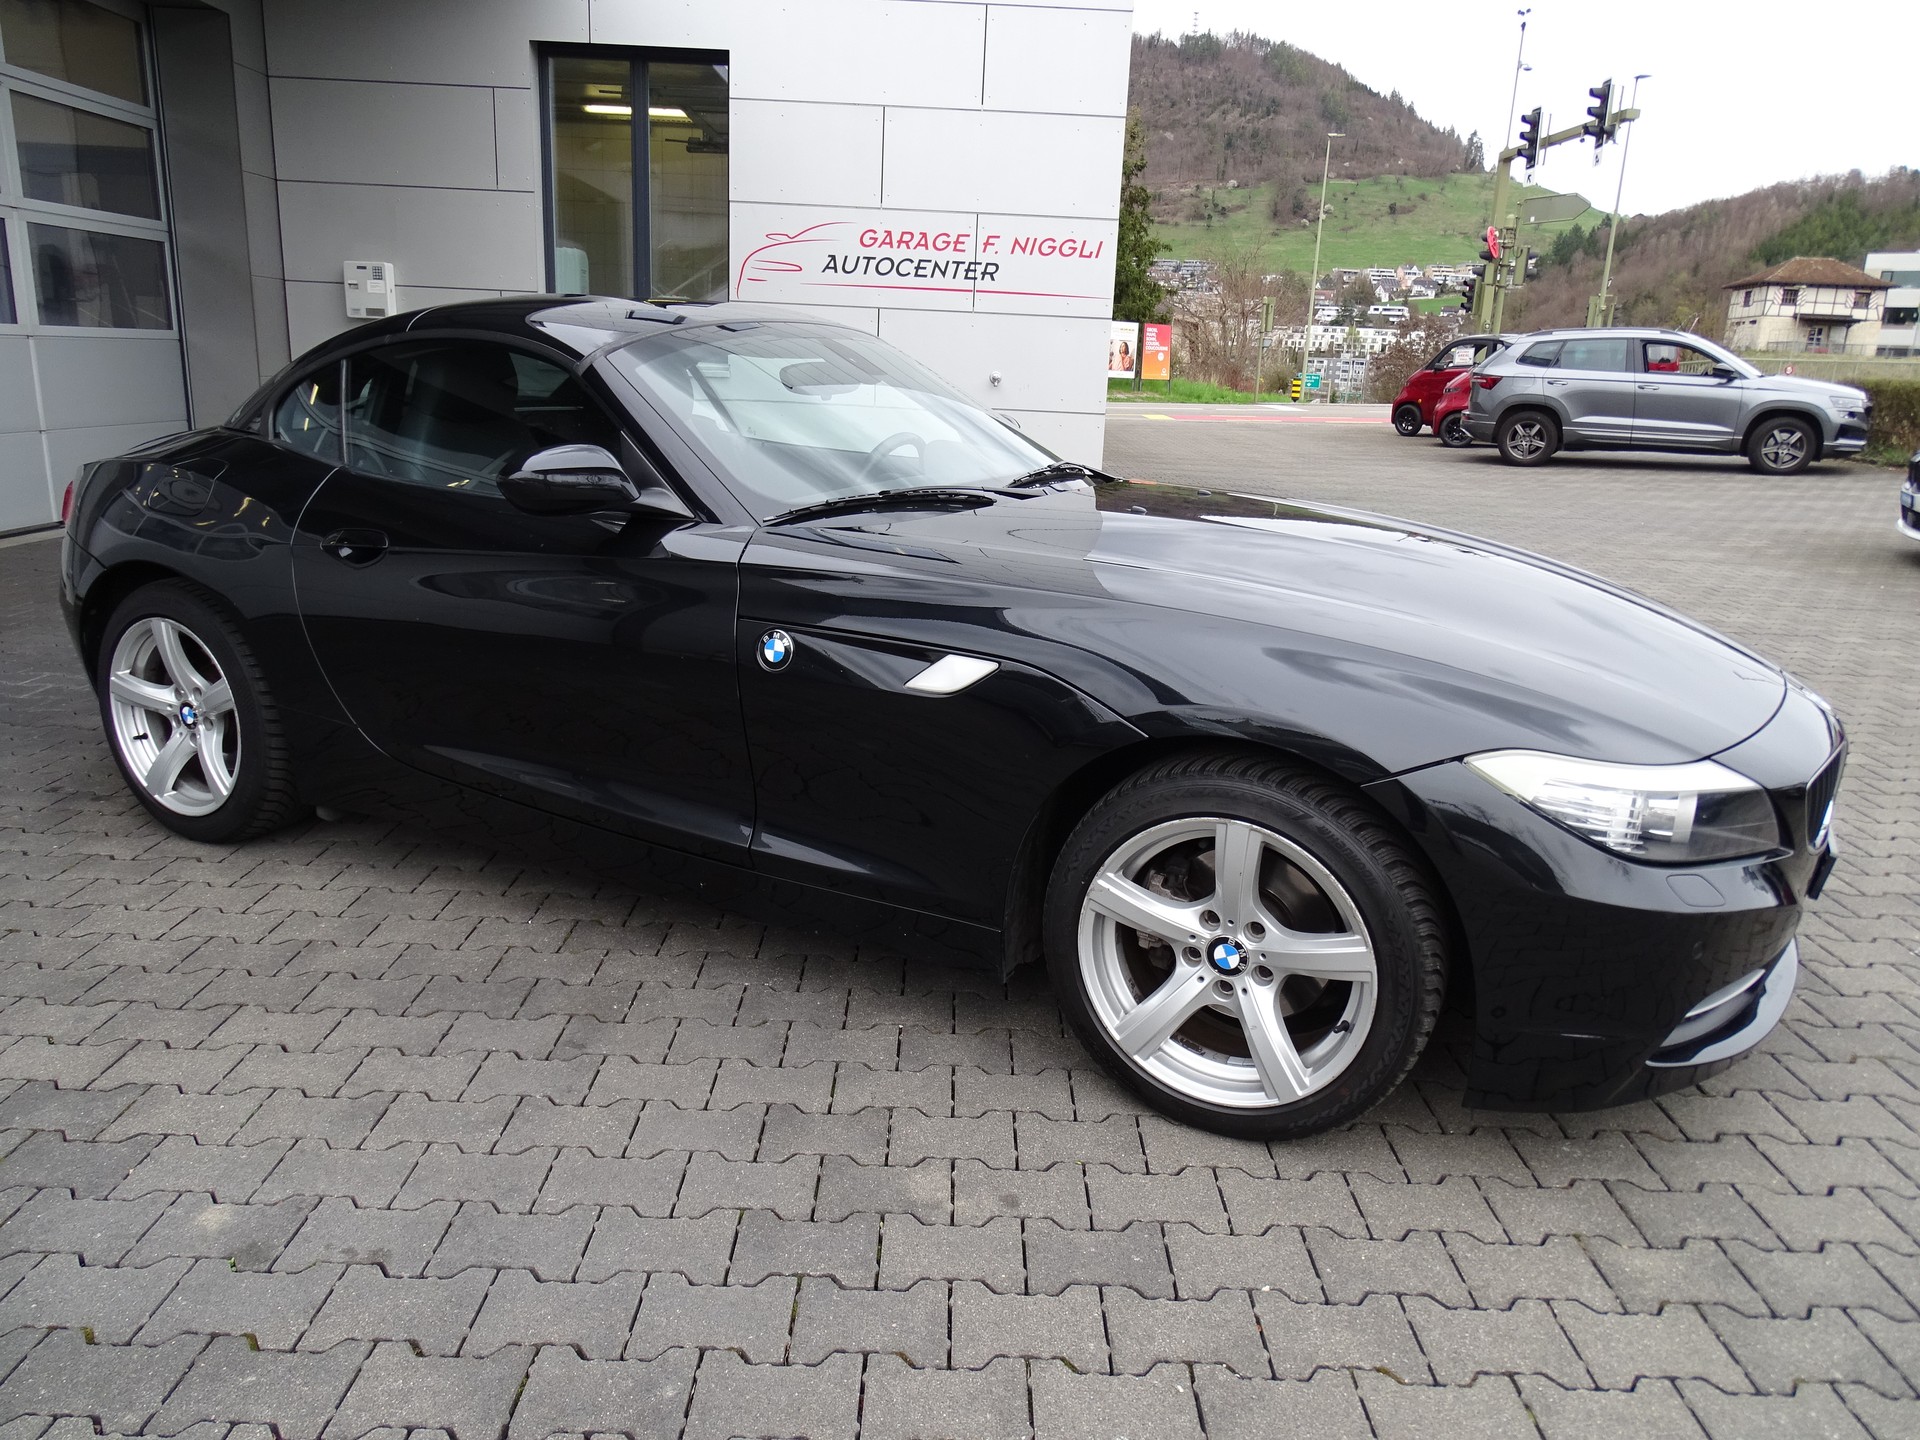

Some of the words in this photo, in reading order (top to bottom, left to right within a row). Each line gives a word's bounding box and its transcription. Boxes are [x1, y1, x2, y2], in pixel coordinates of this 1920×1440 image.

[859, 229, 971, 253] GARAGE
[982, 234, 1000, 255] F.
[1010, 236, 1104, 260] NIGGLI
[822, 254, 1000, 282] AUTOCENTER
[763, 631, 790, 646] BMW
[1227, 938, 1247, 971] BMW
